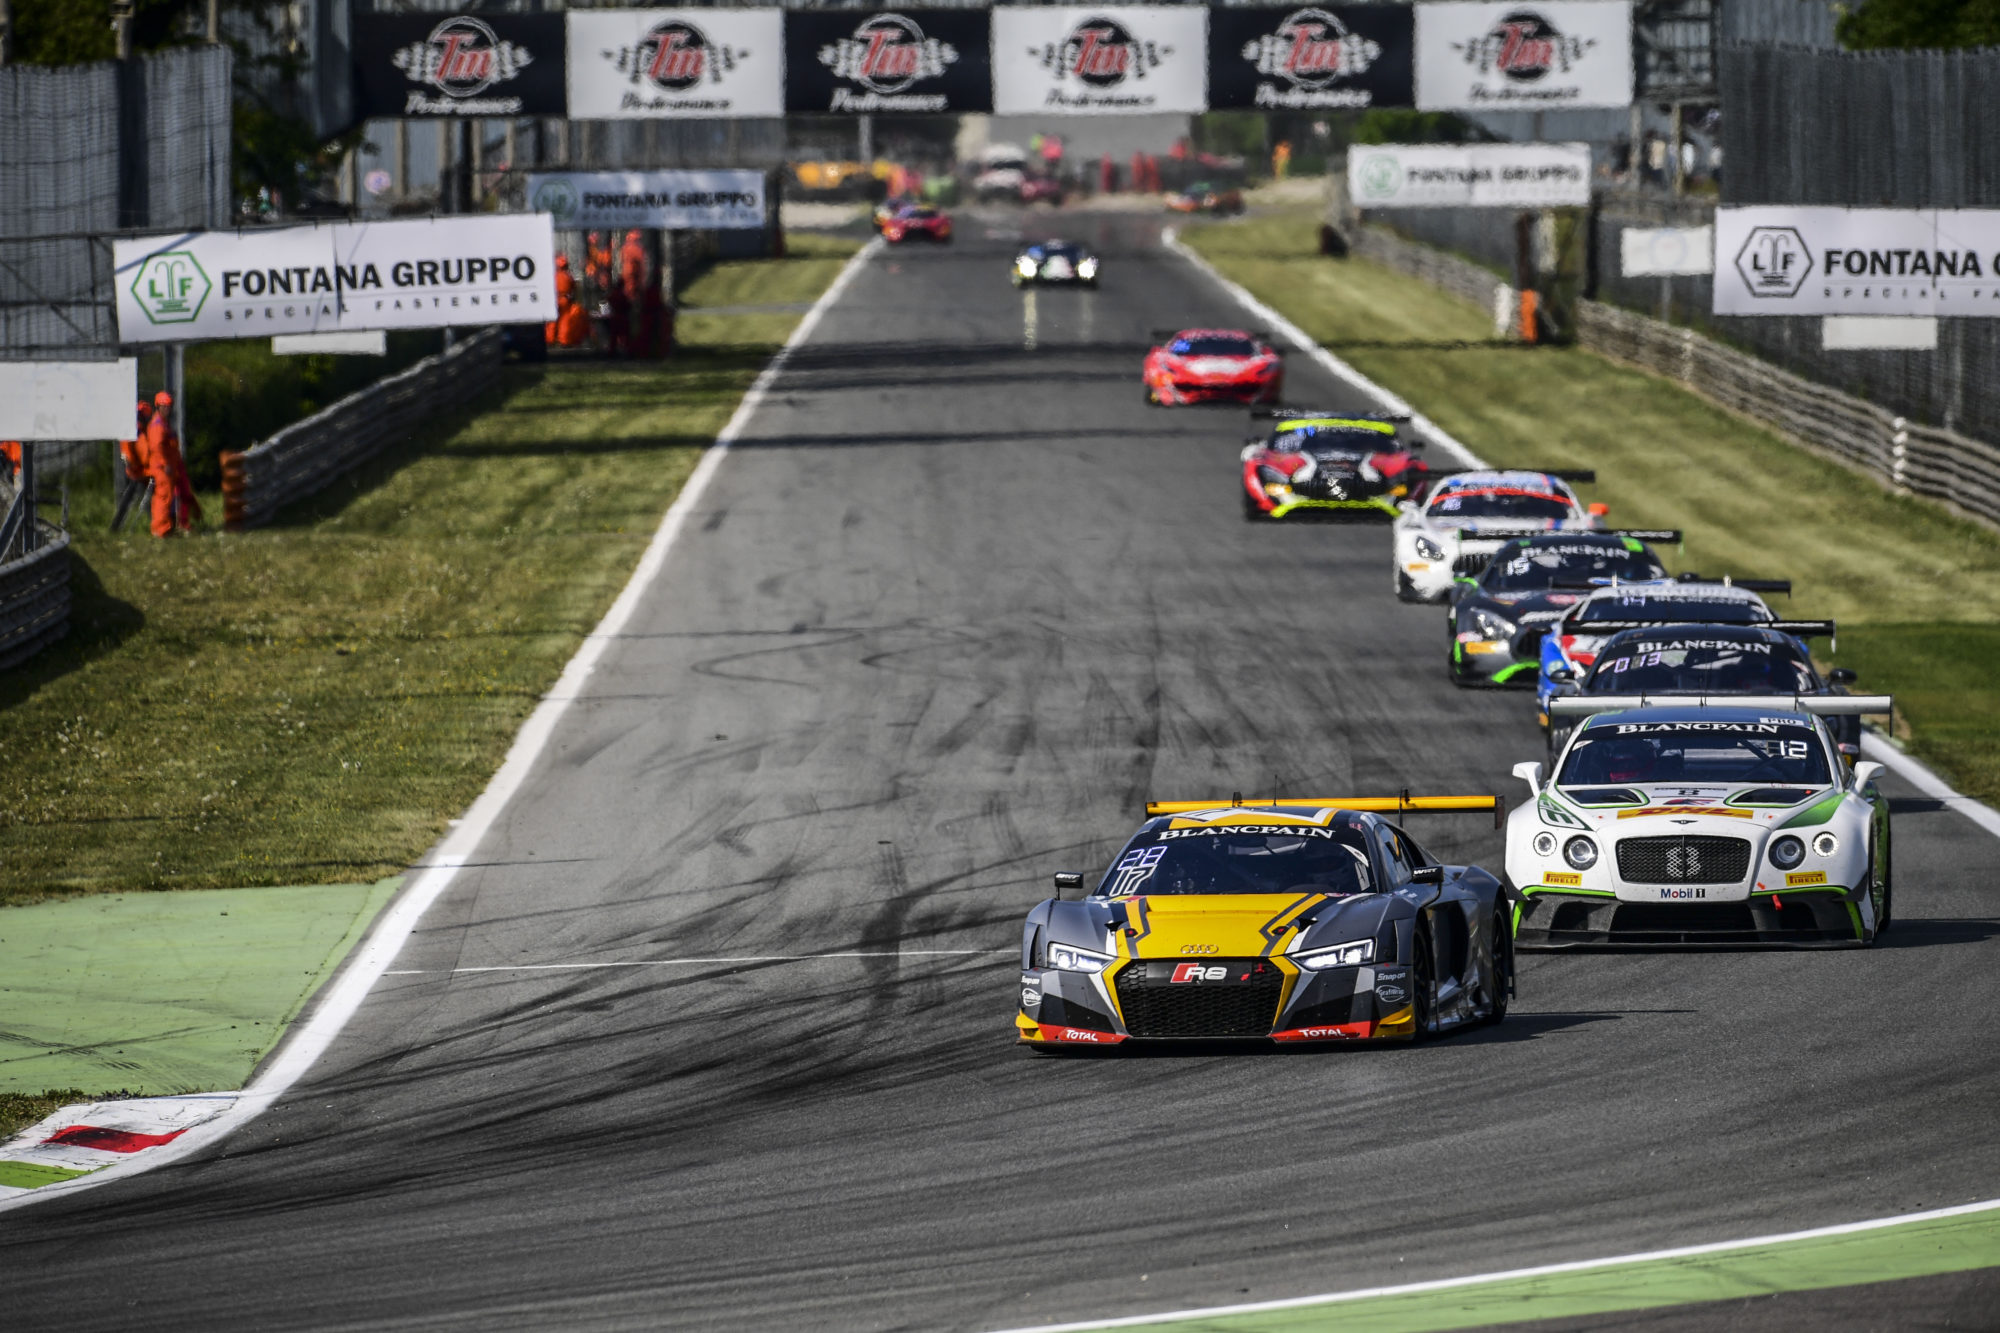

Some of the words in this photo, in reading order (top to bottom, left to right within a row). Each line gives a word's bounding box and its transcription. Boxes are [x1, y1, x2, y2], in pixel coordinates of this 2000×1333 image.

[433, 31, 492, 80] Tm
[648, 31, 704, 79] Tm
[1825, 249, 1983, 276] FONTANA
[223, 263, 383, 297] FONTANA
[392, 256, 536, 287] GRUPPO
[224, 303, 350, 320] SPECIAL
[375, 292, 539, 310] FASTENERS
[1637, 639, 1772, 654] BLANCPAIN
[1616, 722, 1780, 735] BLANCPAIN
[1157, 825, 1336, 841] BLANCPAIN
[1545, 873, 1580, 884] PIRELLI
[1789, 873, 1824, 884] PIRELLI
[1661, 888, 1693, 899] Mobil
[1183, 966, 1228, 981] R8
[1066, 1029, 1098, 1042] TOTAL
[1299, 1028, 1346, 1038] TOTAL
